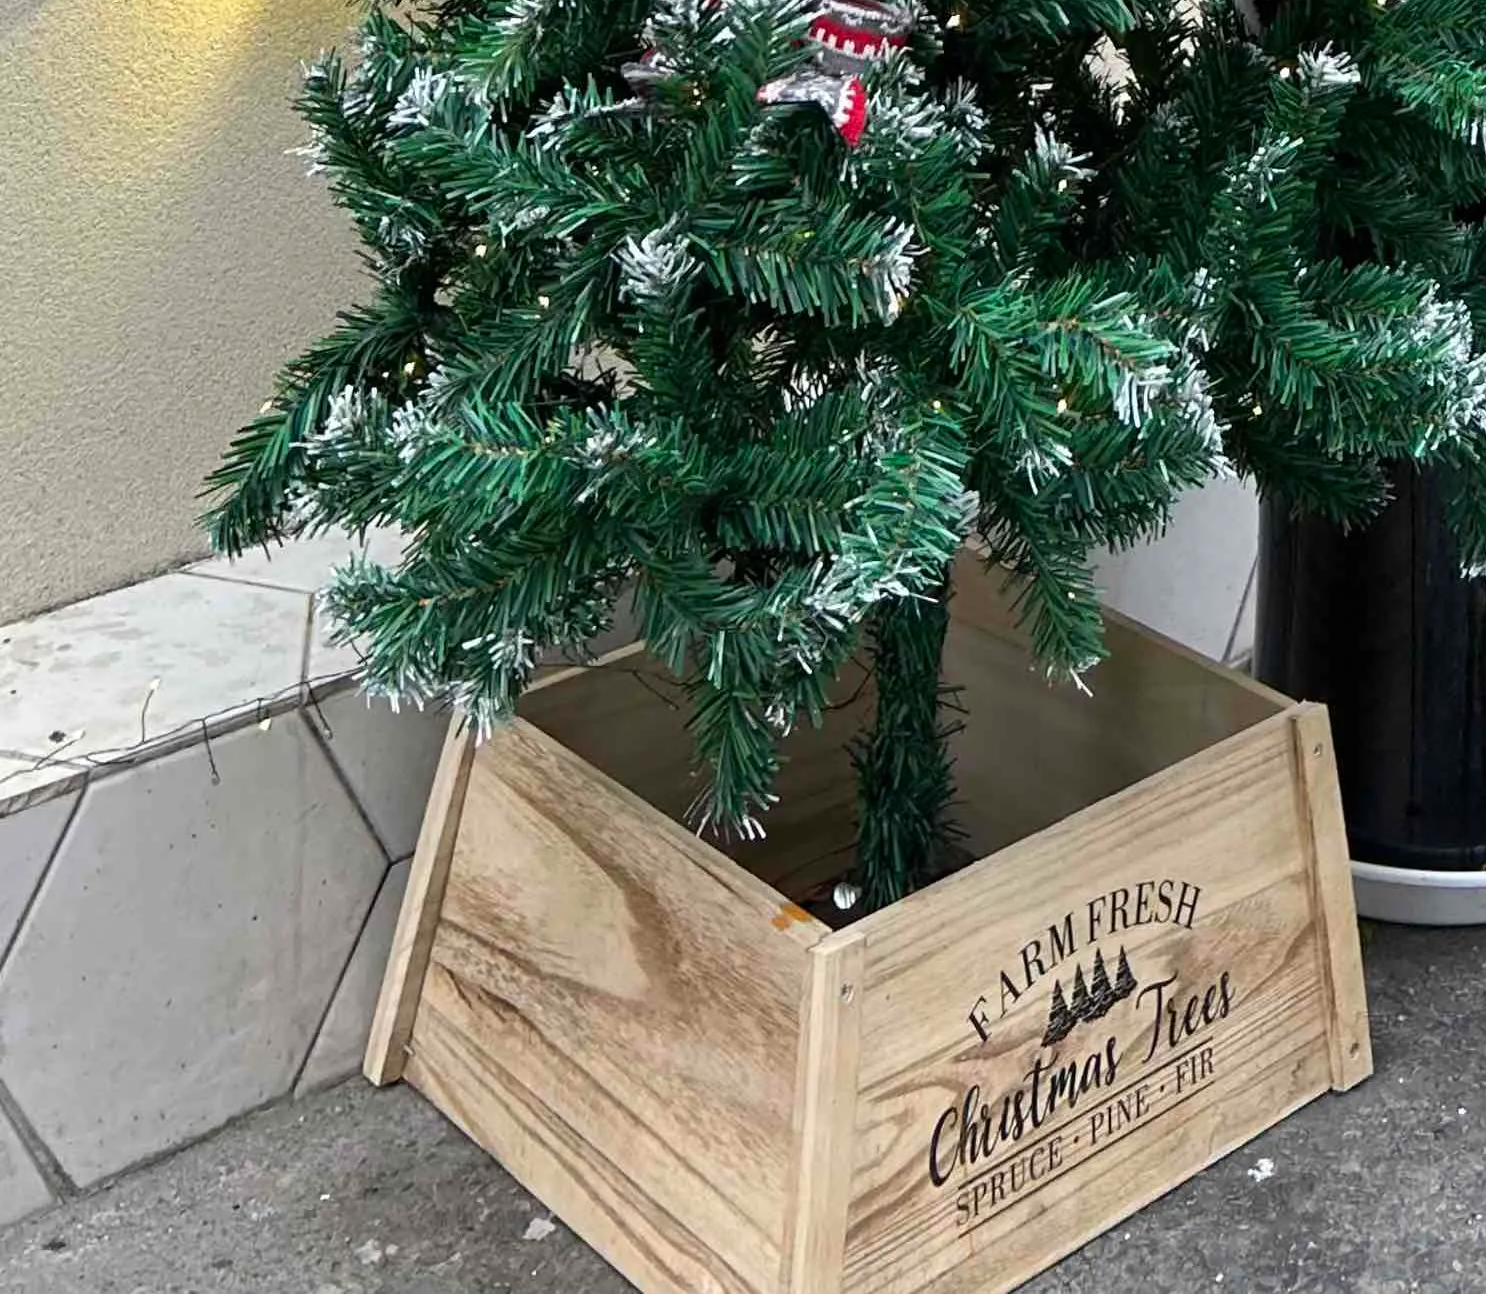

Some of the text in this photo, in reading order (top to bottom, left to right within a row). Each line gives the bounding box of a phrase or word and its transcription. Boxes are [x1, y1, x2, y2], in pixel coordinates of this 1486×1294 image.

[967, 879, 1201, 1043] FARM FRESH
[928, 970, 1236, 1187] Christmas Trees
[954, 1046, 1214, 1227] SPRUCE PINE FIR
